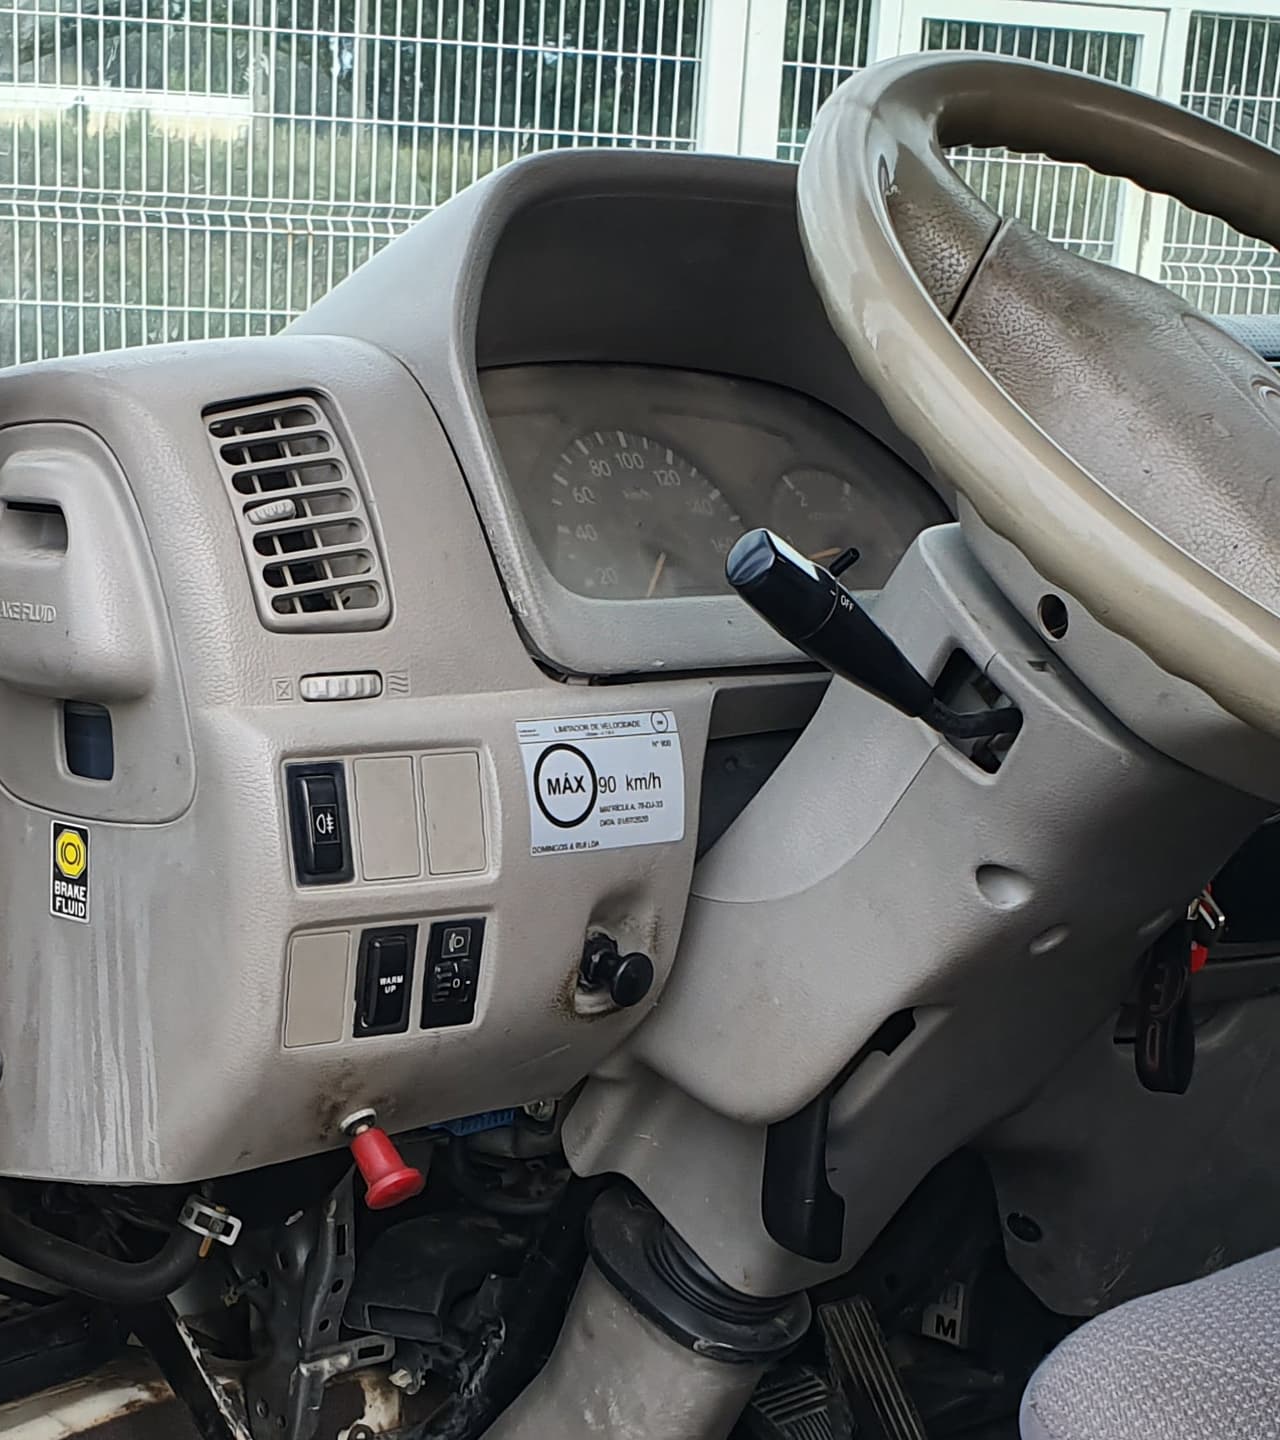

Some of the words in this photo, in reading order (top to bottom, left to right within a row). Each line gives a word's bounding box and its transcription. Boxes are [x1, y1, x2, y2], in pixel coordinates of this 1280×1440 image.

[589, 460, 611, 477] 80
[616, 452, 644, 470] 100
[653, 469, 681, 487] 120
[573, 486, 595, 504] 60
[575, 524, 598, 542] 40
[597, 567, 617, 586] 20
[21, 601, 57, 623] FLUID
[840, 594, 855, 612] OFF
[547, 772, 586, 796] MÁX
[598, 775, 617, 794] 90
[625, 772, 662, 792] km/h
[54, 880, 87, 901] BRAKE
[55, 897, 86, 917] FLUID
[379, 974, 404, 987] WARM
[384, 985, 397, 994] UP
[935, 1314, 957, 1340] M
